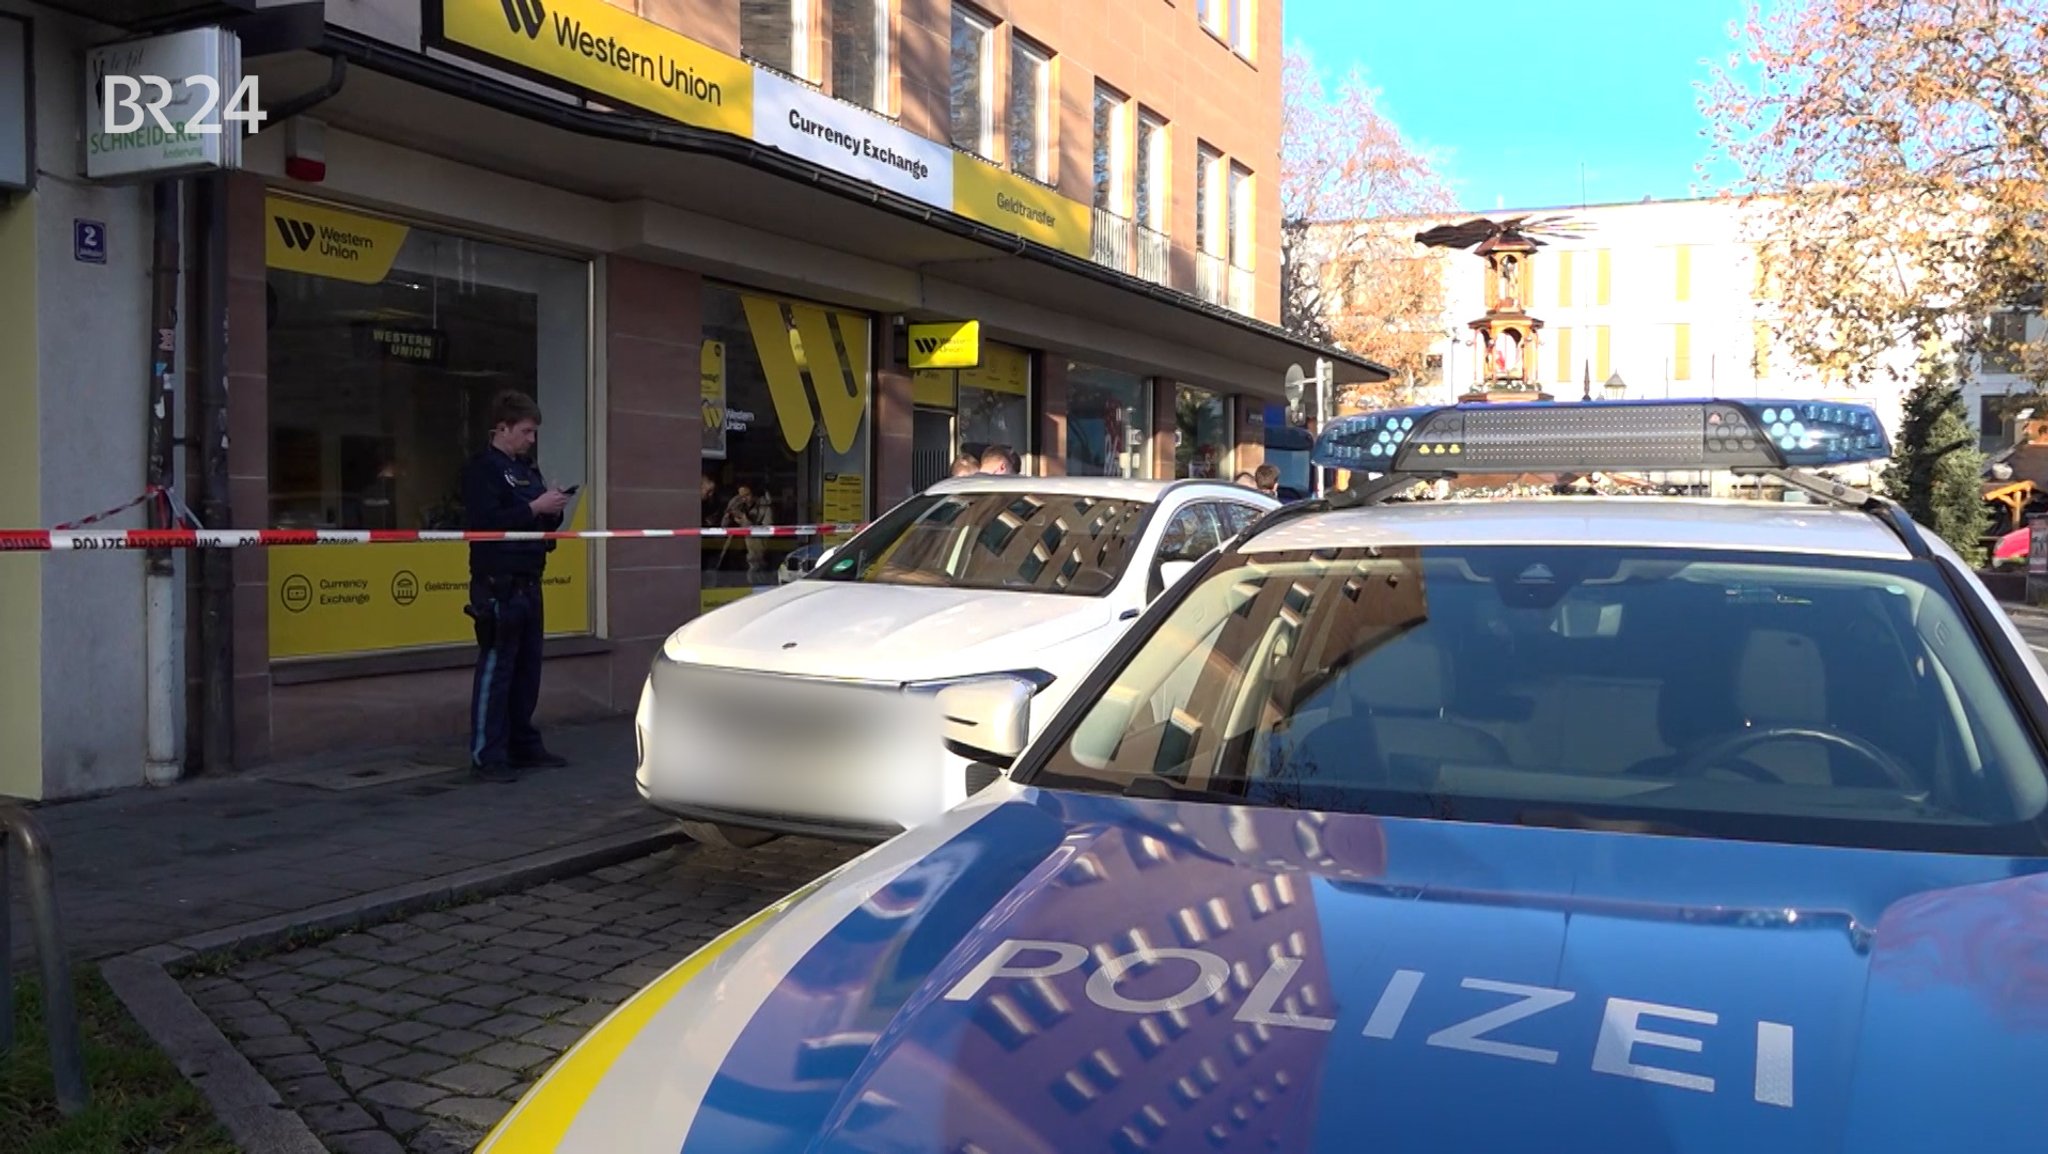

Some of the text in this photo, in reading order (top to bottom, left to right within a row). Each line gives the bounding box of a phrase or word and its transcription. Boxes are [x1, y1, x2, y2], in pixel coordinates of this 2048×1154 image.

[553, 12, 653, 80] Western
[659, 53, 721, 107] Union
[789, 109, 929, 180] Currency Exchange
[997, 193, 1056, 228] Geldtransfer
[84, 225, 98, 247] 2
[319, 225, 374, 249] Western
[319, 241, 359, 262] Union
[372, 328, 432, 347] WESTERN
[390, 343, 432, 360] UNION
[319, 578, 369, 590] Currency
[319, 593, 370, 606] Exchange
[943, 940, 1796, 1108] POLIZEI
